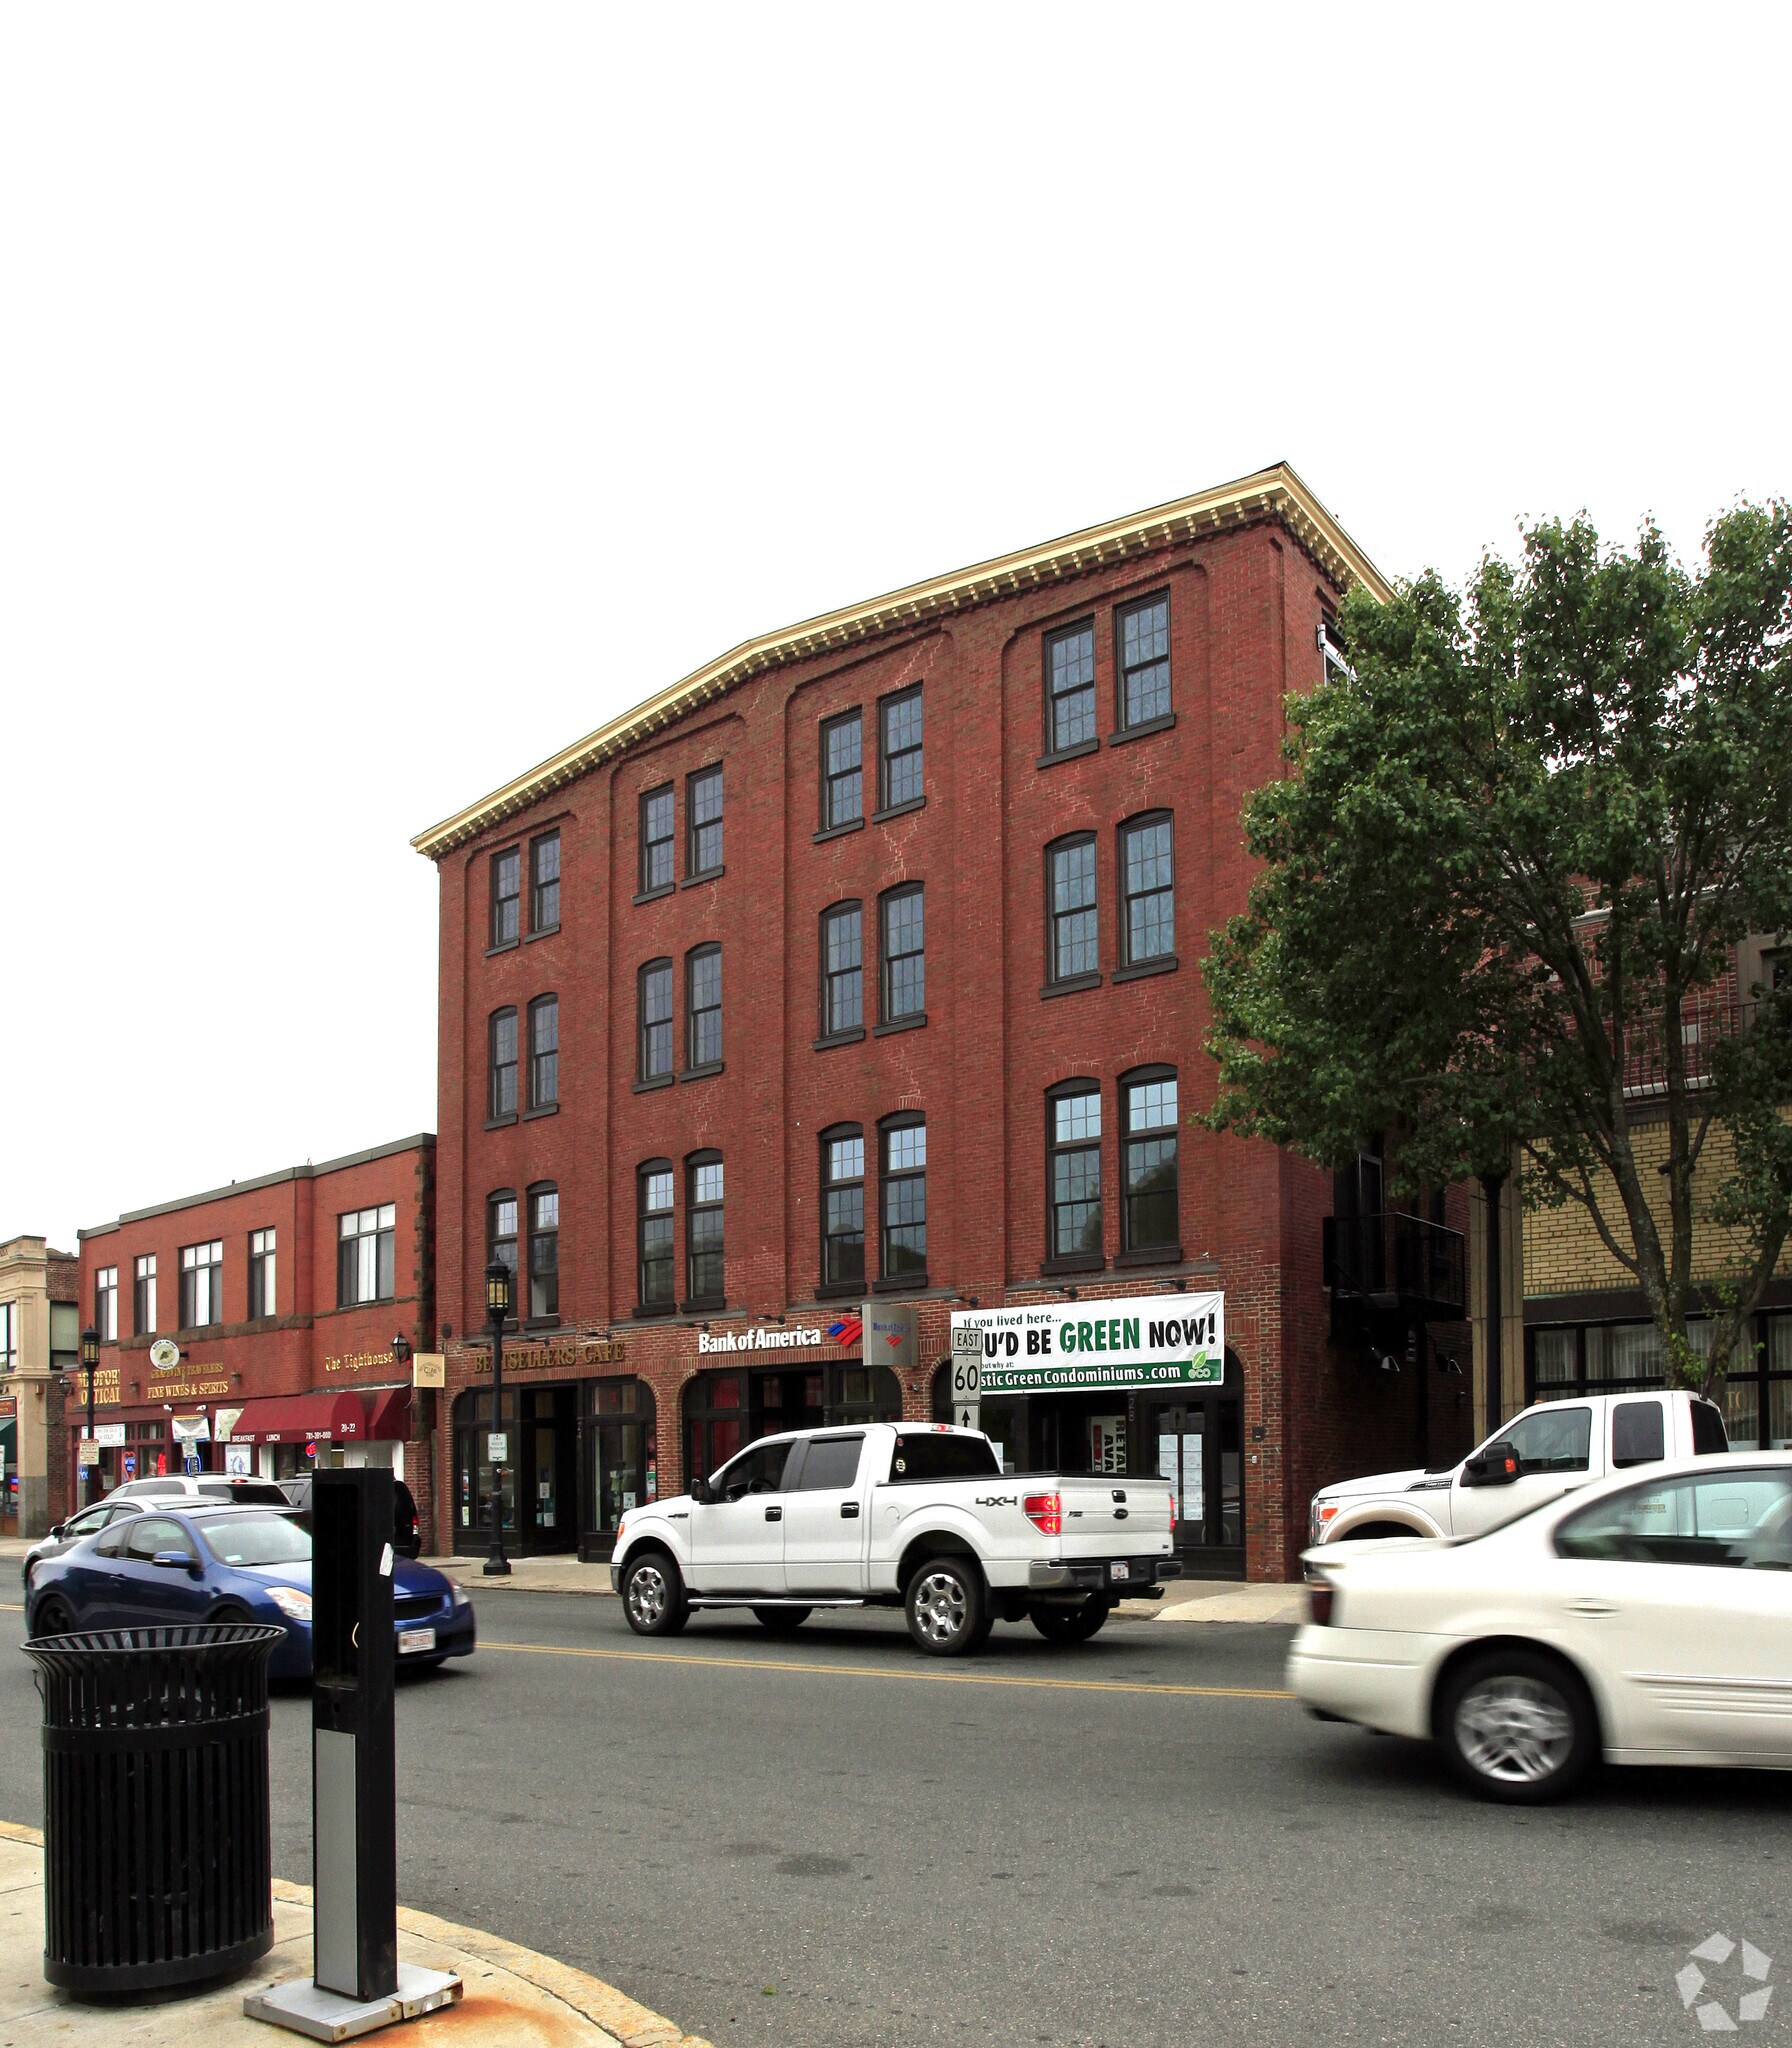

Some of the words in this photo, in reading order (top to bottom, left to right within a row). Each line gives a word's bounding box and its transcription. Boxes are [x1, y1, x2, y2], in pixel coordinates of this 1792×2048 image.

[963, 1317, 972, 1328] If
[975, 1319, 993, 1329] you
[996, 1314, 1023, 1327] lived
[1026, 1313, 1061, 1324] here...
[957, 1333, 979, 1347] EAST
[983, 1331, 1019, 1358] U'D
[1026, 1329, 1052, 1355] BE
[1060, 1317, 1140, 1353] GREEN
[1149, 1312, 1216, 1348] NOW!
[325, 1355, 341, 1372] The
[343, 1351, 394, 1371] Lighthouse
[474, 1346, 576, 1373] BETSELLERS
[582, 1342, 625, 1364] CAFE
[992, 1361, 1004, 1370] why
[77, 1368, 120, 1388] MEDFOR
[954, 1365, 979, 1391] 60
[1188, 1368, 1211, 1379] eco
[81, 1386, 120, 1406] OTICAL
[147, 1386, 165, 1399] FINE
[165, 1384, 190, 1397] WINES
[191, 1383, 198, 1396] &
[198, 1380, 229, 1395] SPIRITS
[341, 1422, 356, 1433] 20-22
[265, 1433, 281, 1442] LUNCH
